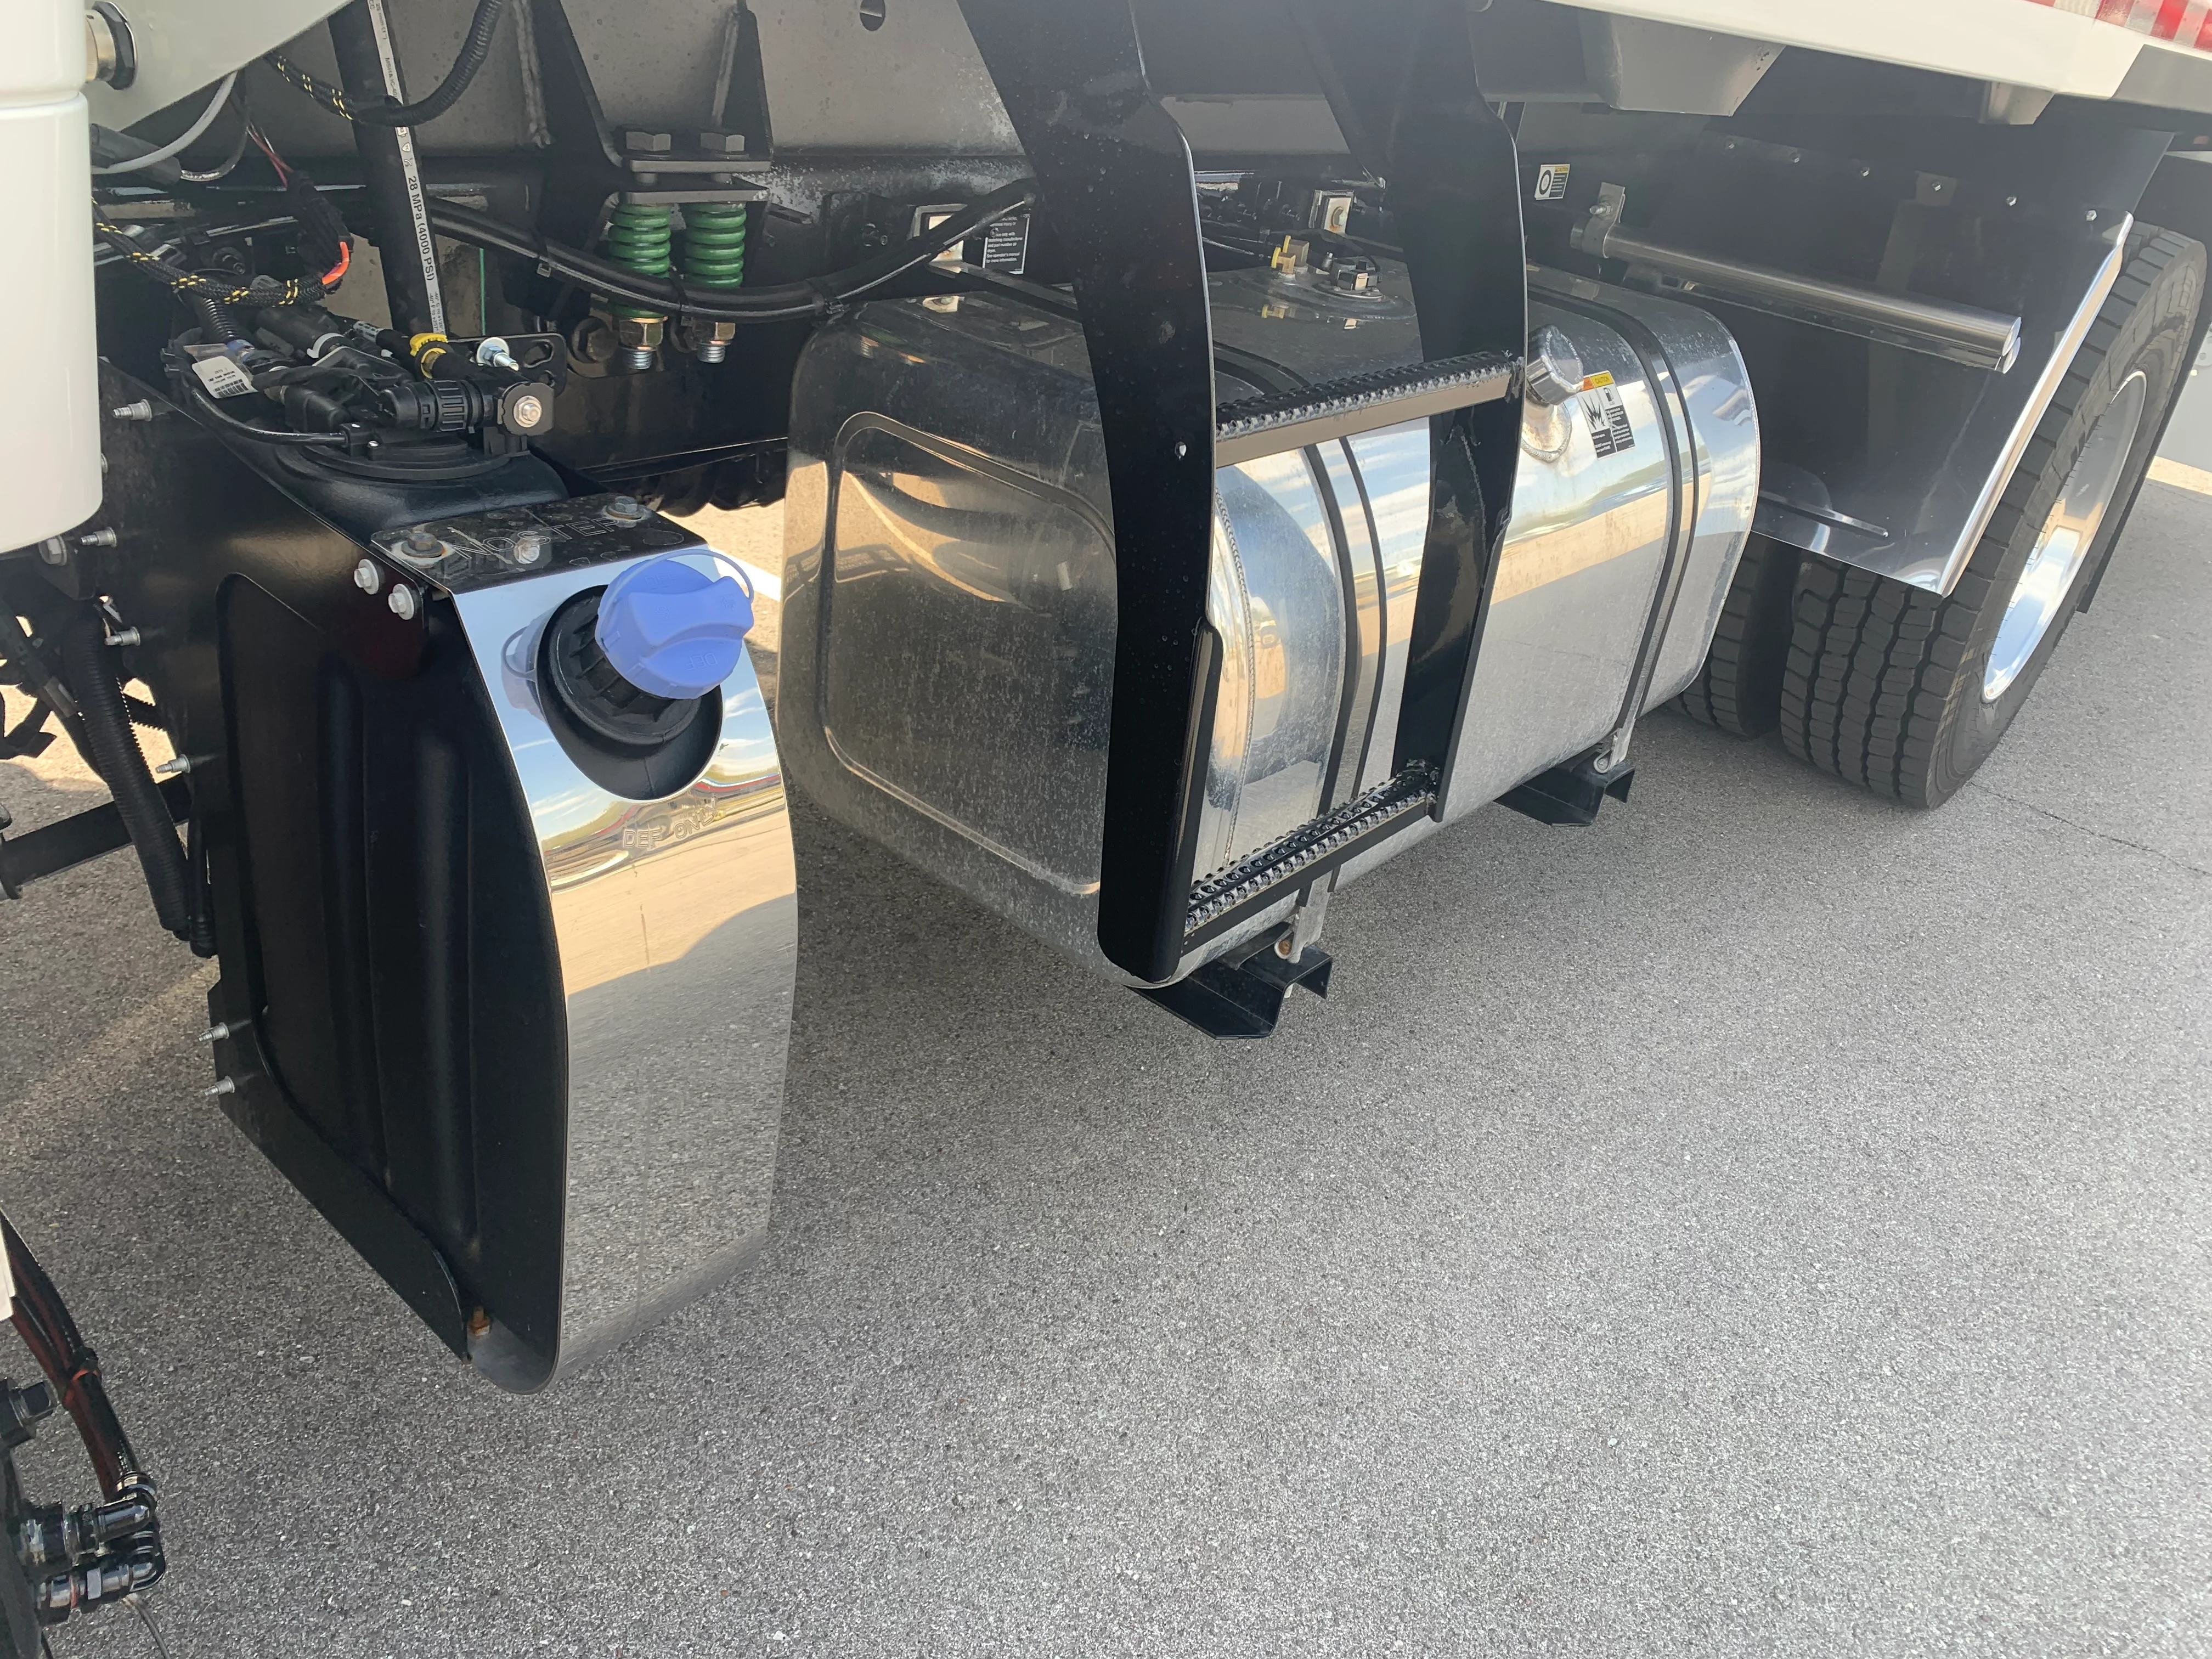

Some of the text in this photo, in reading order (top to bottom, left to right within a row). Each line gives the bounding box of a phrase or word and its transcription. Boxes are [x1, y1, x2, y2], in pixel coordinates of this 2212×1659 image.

[385, 57, 393, 78] MSHA
[408, 176, 435, 281] 28 MPa (4000 PSI)
[1595, 376, 1610, 384] CAUTION
[452, 517, 620, 560] NO STEP
[645, 572, 678, 589] DEF
[685, 651, 719, 672] DEF
[623, 796, 719, 848] DEF ONLY
